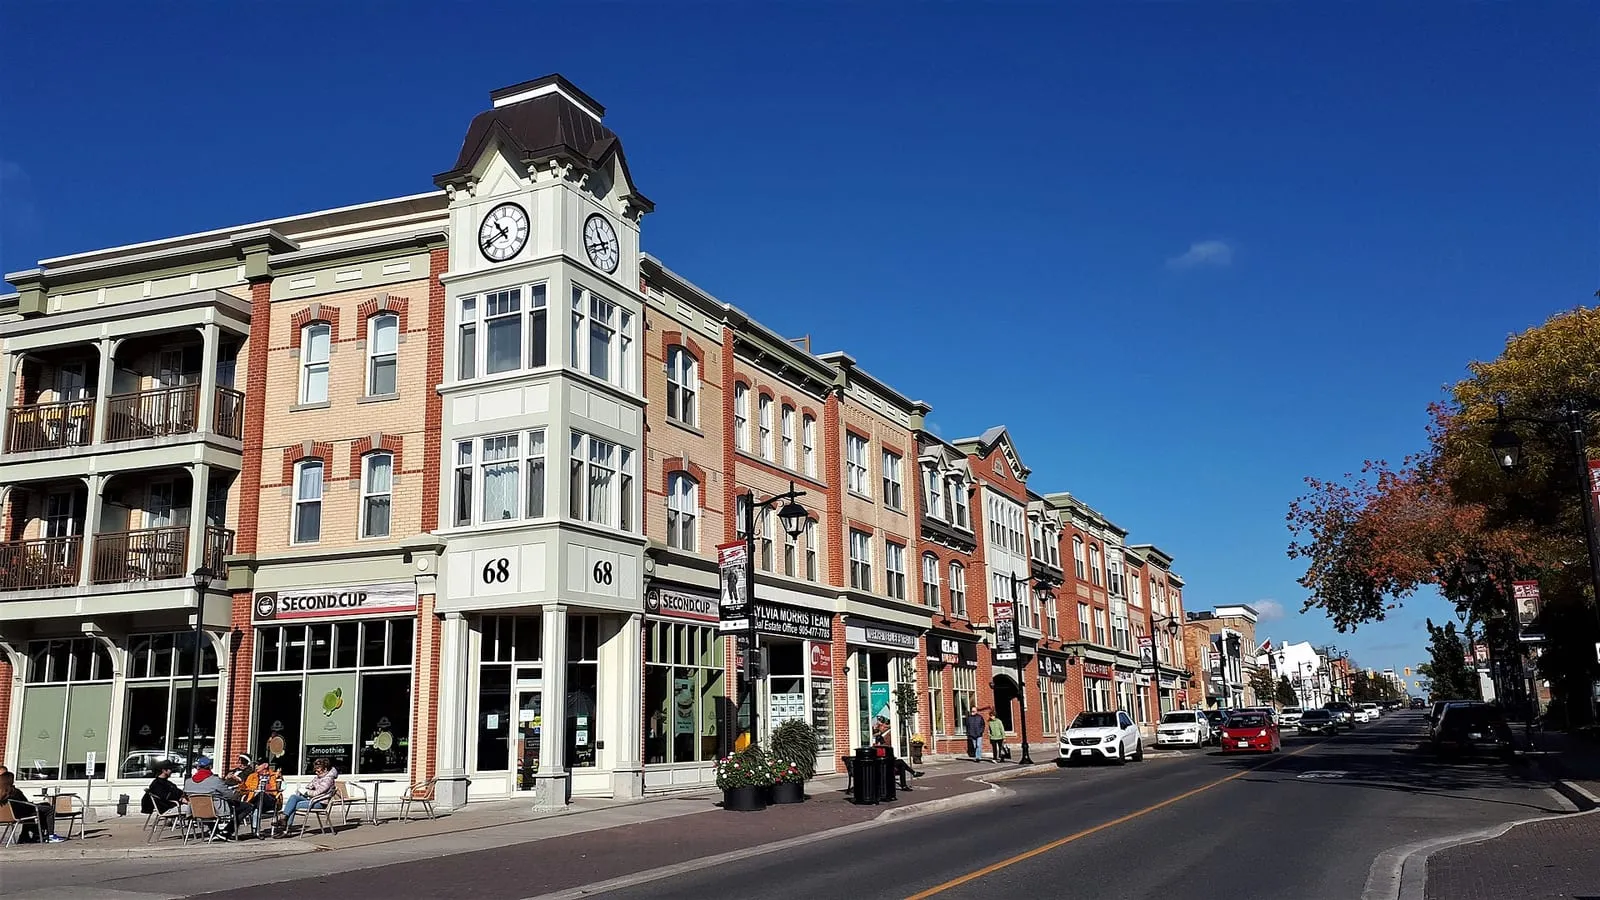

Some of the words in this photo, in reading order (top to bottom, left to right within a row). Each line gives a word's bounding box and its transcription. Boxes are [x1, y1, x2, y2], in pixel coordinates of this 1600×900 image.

[483, 558, 509, 584] 68
[593, 560, 613, 585] 68
[281, 594, 337, 611] SECOND
[338, 592, 367, 607] CUP
[663, 594, 694, 611] SECOND
[695, 599, 711, 613] CUP
[764, 620, 781, 632] Estate
[782, 623, 798, 634] Office
[780, 608, 809, 625] MORRIS
[811, 613, 830, 628] TEAM
[311, 746, 345, 754] Smoothies
